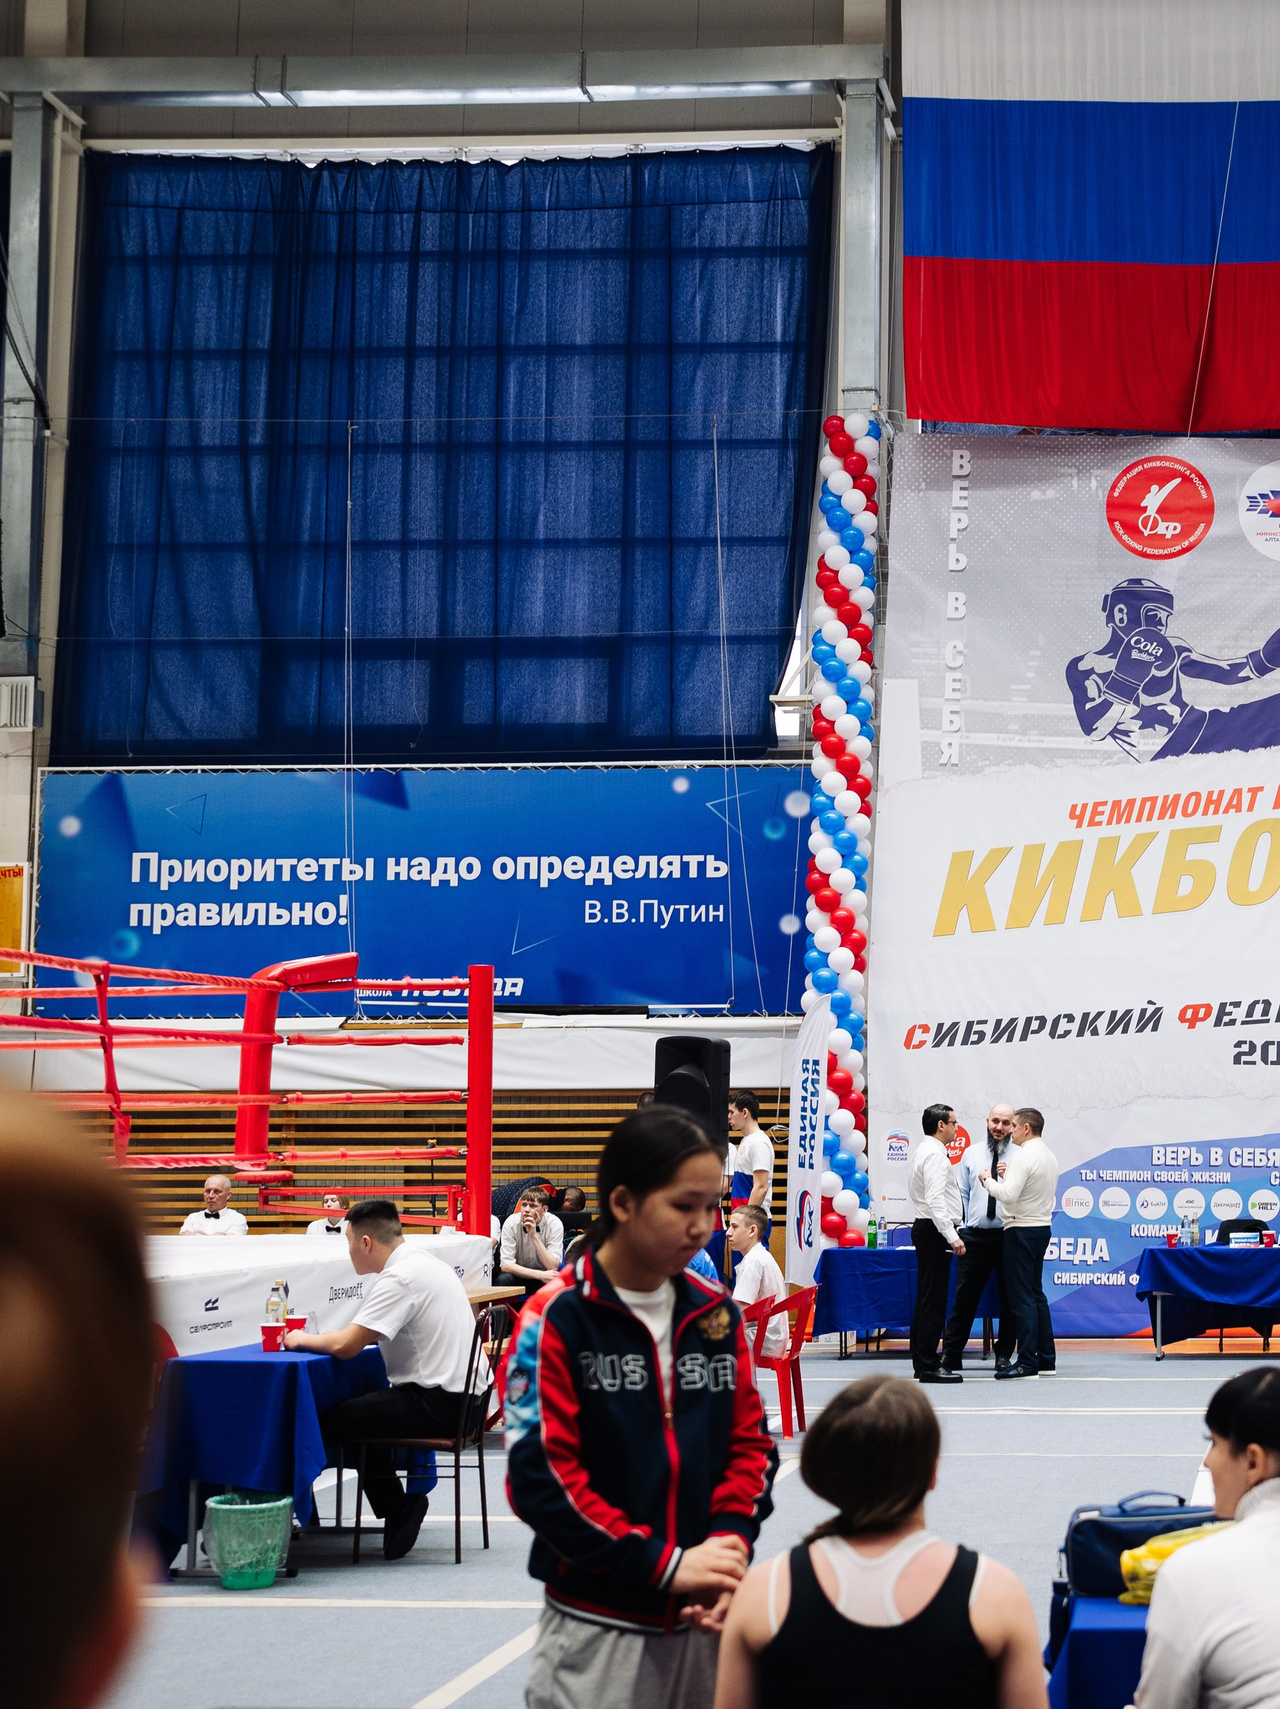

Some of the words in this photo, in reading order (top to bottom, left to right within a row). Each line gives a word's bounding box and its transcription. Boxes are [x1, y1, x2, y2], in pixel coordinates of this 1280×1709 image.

[1113, 465, 1144, 498] ФЕДЕРАЦИЯ
[1144, 460, 1191, 477] КИКБОКСИНГА
[1189, 473, 1208, 499] РОССИИ
[948, 450, 971, 572] ВЕРЬ
[1113, 520, 1144, 551] KICK-BOXING
[1143, 544, 1182, 555] FEDERATION
[1181, 540, 1191, 548] OF
[1189, 522, 1206, 543] RUSSIA
[947, 592, 967, 621] В
[1130, 636, 1163, 657] Cola
[939, 640, 964, 767] СЕБЯ
[1067, 786, 1265, 829] ЧЕМПИОНАТ
[0, 867, 24, 880] ЧТЫ!
[130, 851, 376, 886] Приоритеты
[386, 857, 482, 890] надо
[491, 852, 729, 889] определять
[128, 894, 350, 936] правильно!
[584, 898, 725, 930] В.В.Путин
[903, 999, 1164, 1051] СИБИРСКИЙ
[798, 1058, 810, 1169] ЕДИНАЯ
[808, 1059, 820, 1170] РОССИЯ
[1151, 1146, 1203, 1166] ВЕРЬ
[1209, 1147, 1223, 1166] В
[1229, 1147, 1280, 1167] СЕБЯ
[1080, 1169, 1097, 1181] ТЫ
[1099, 1170, 1151, 1182] ЧЕМПИОН
[1153, 1169, 1189, 1183] СВОЕЙ
[1191, 1171, 1231, 1184] ЖИЗНИ
[1053, 1271, 1126, 1286] СИБИРСКИЙ
